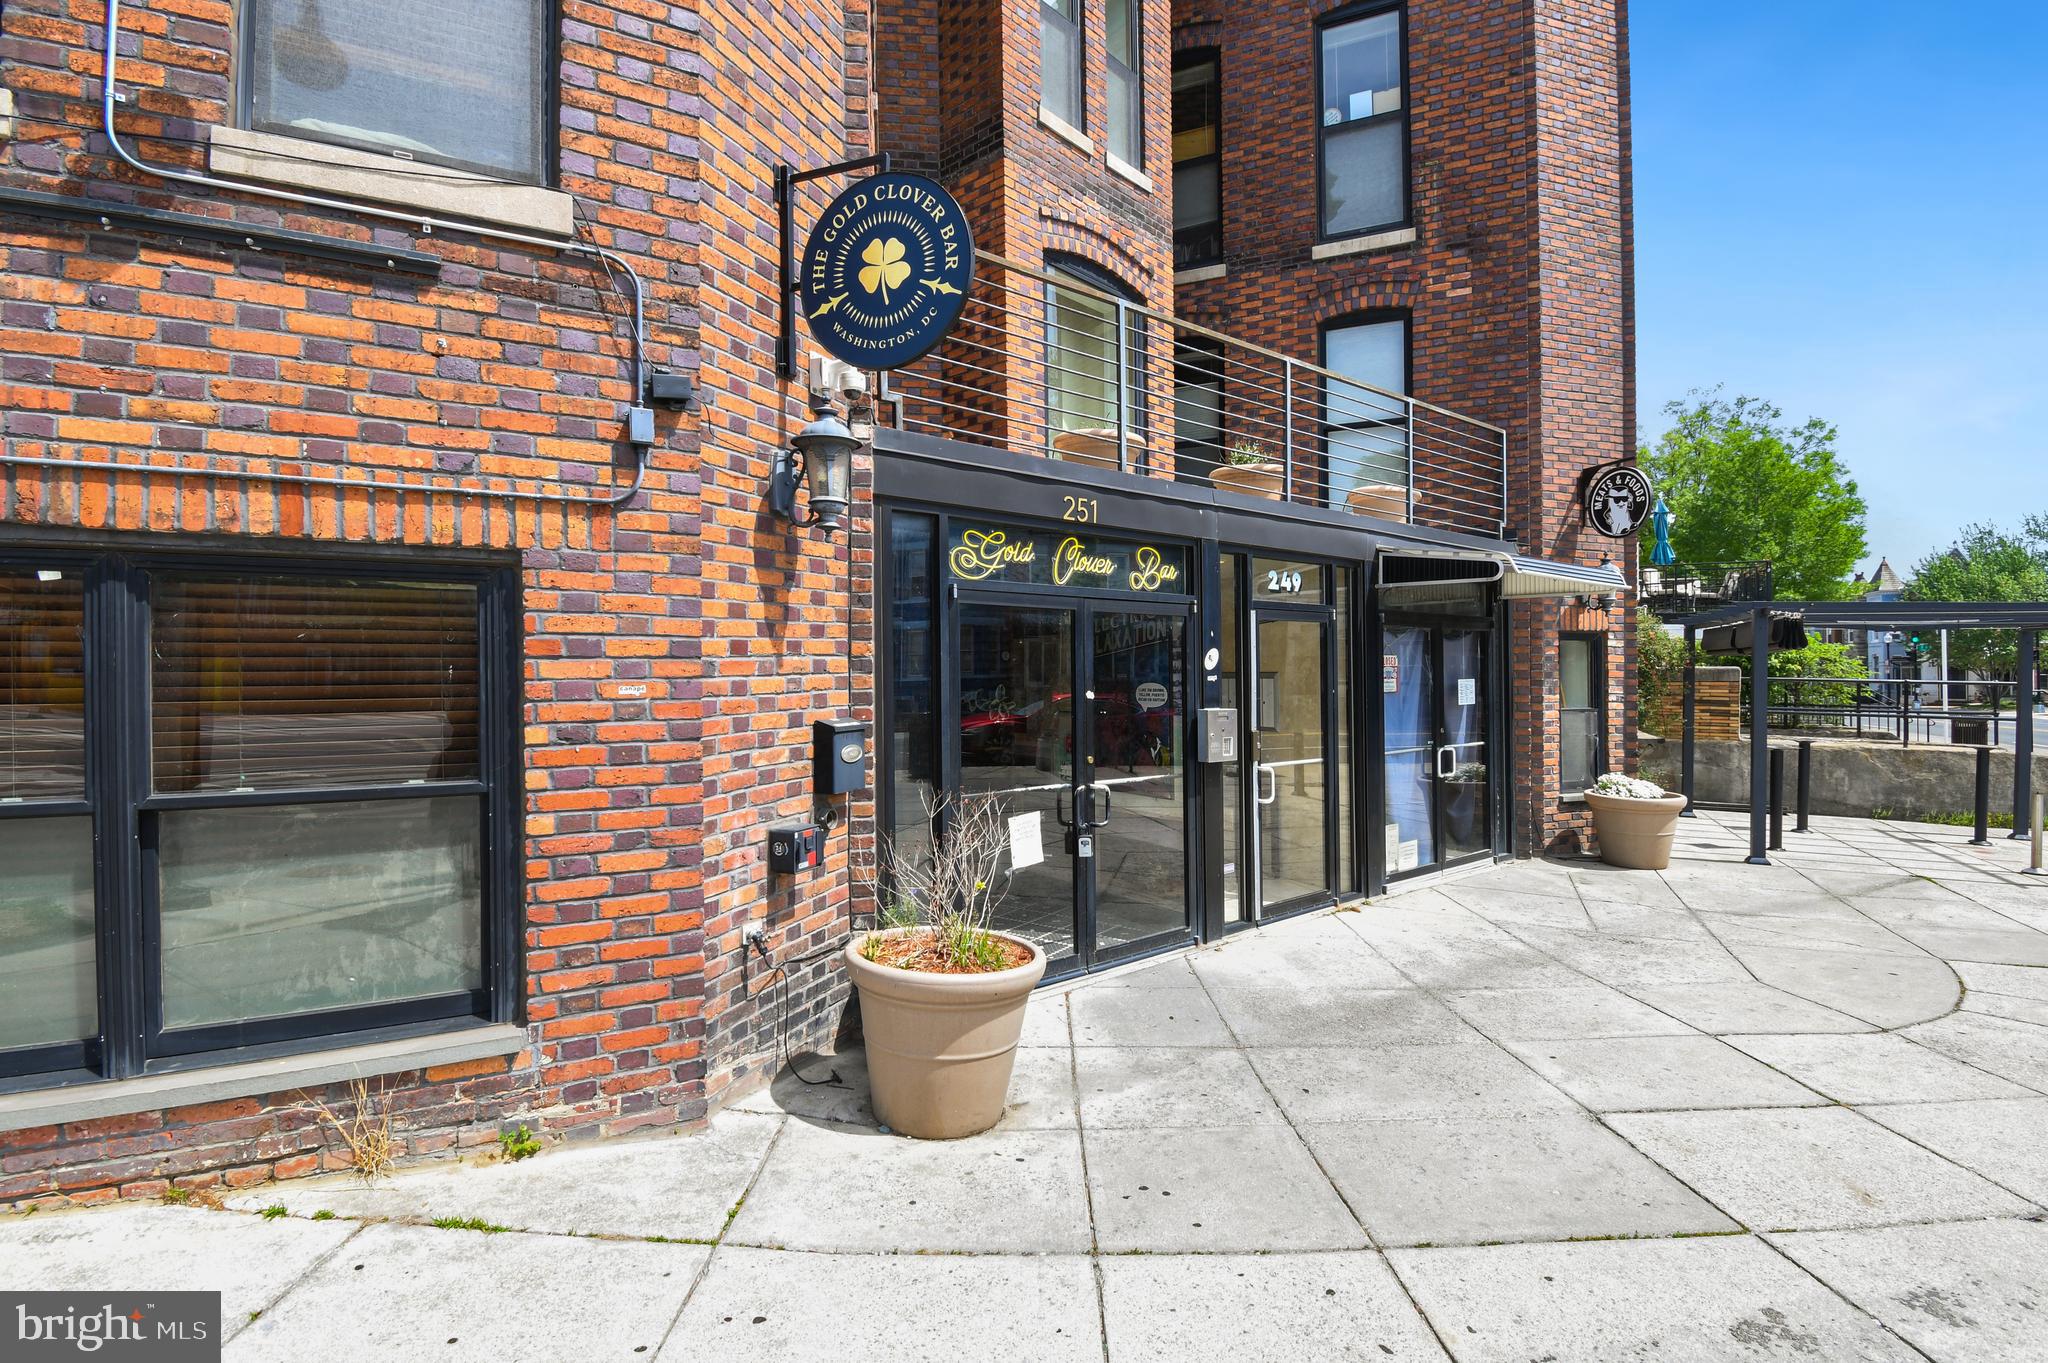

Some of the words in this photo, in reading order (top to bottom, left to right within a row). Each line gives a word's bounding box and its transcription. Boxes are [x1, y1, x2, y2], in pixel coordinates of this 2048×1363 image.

[813, 249, 829, 295] THE
[823, 194, 868, 243] GOLD
[874, 184, 946, 224] CLOVER
[940, 223, 959, 271] BAR
[832, 321, 920, 350] WASHINGTON,
[921, 306, 938, 327] DC
[1063, 495, 1098, 524] 251
[1594, 480, 1613, 510] MEATS
[1616, 475, 1622, 484] &
[1625, 476, 1645, 502] FOODS
[949, 529, 1035, 580] Gold
[1128, 546, 1179, 590] Bar
[1267, 570, 1302, 592] 249
[1095, 618, 1167, 654] LAXATION
